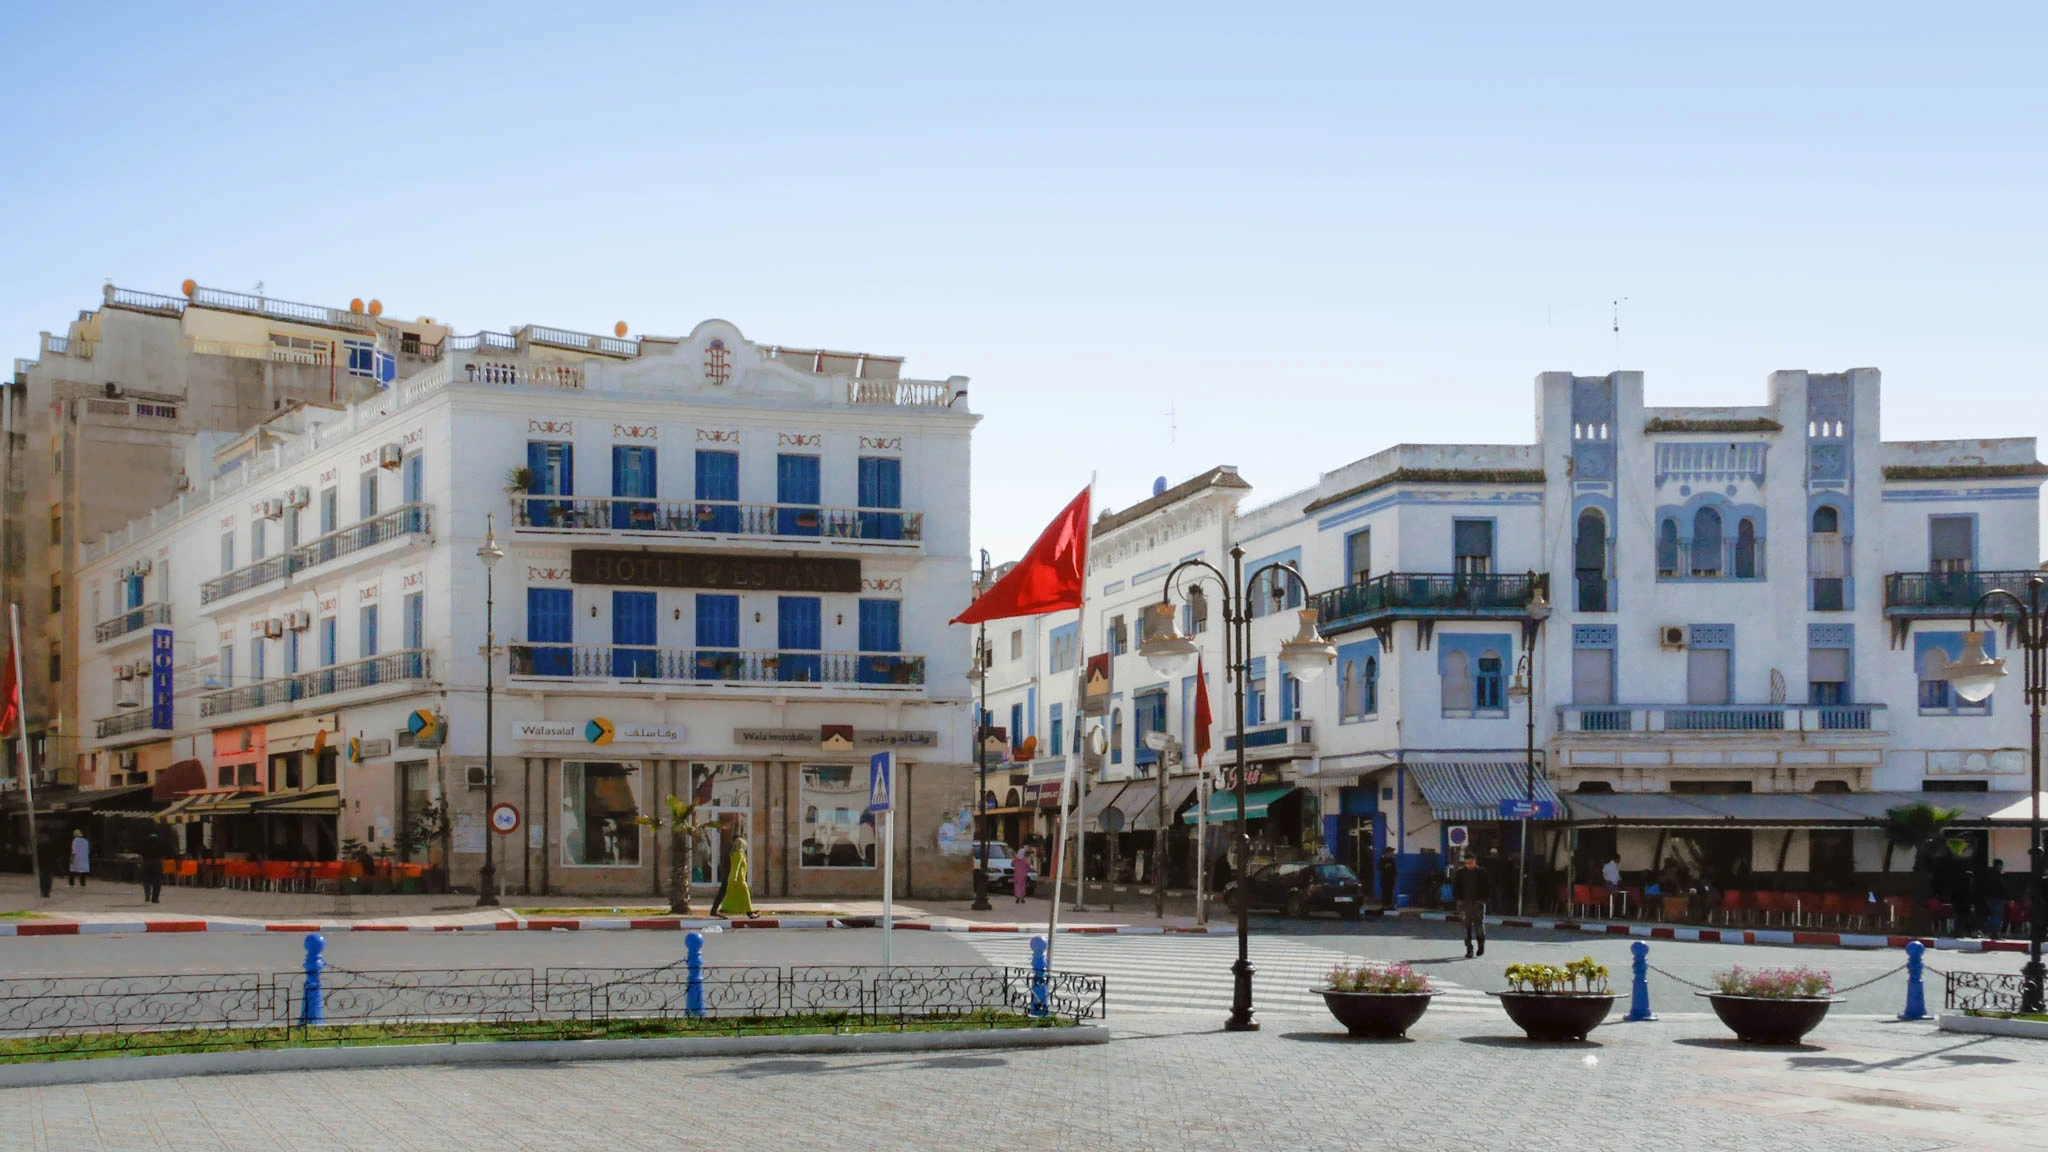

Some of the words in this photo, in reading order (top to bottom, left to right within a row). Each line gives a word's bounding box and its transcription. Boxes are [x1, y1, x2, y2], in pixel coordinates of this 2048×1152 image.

[594, 555, 690, 584] HOTEL
[155, 634, 172, 725] HOTEL
[521, 726, 575, 737] Wafasalaf
